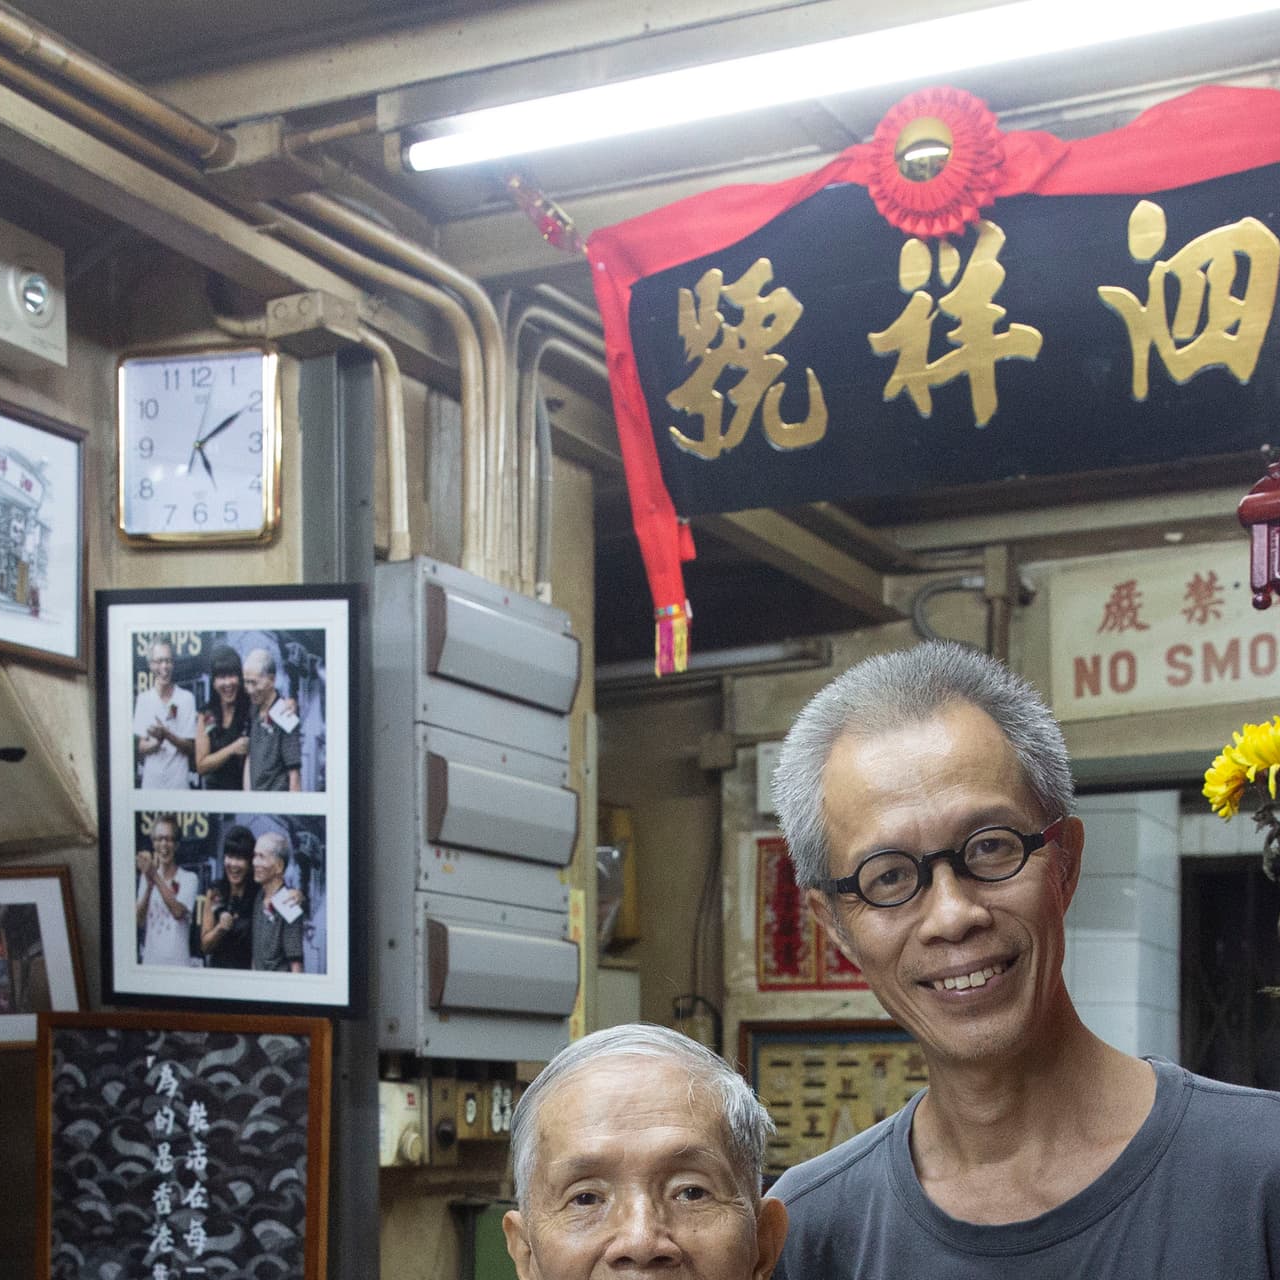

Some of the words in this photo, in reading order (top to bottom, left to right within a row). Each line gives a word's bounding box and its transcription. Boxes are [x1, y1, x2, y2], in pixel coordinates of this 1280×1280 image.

[163, 368, 180, 390] 11
[191, 366, 211, 388] 12
[230, 365, 236, 385] 1
[138, 398, 160, 420] 10
[138, 437, 154, 460] 9
[138, 478, 154, 500] 8
[163, 504, 177, 525] 7
[193, 502, 208, 524] 6
[223, 501, 238, 523] 5
[1073, 649, 1138, 699] NO
